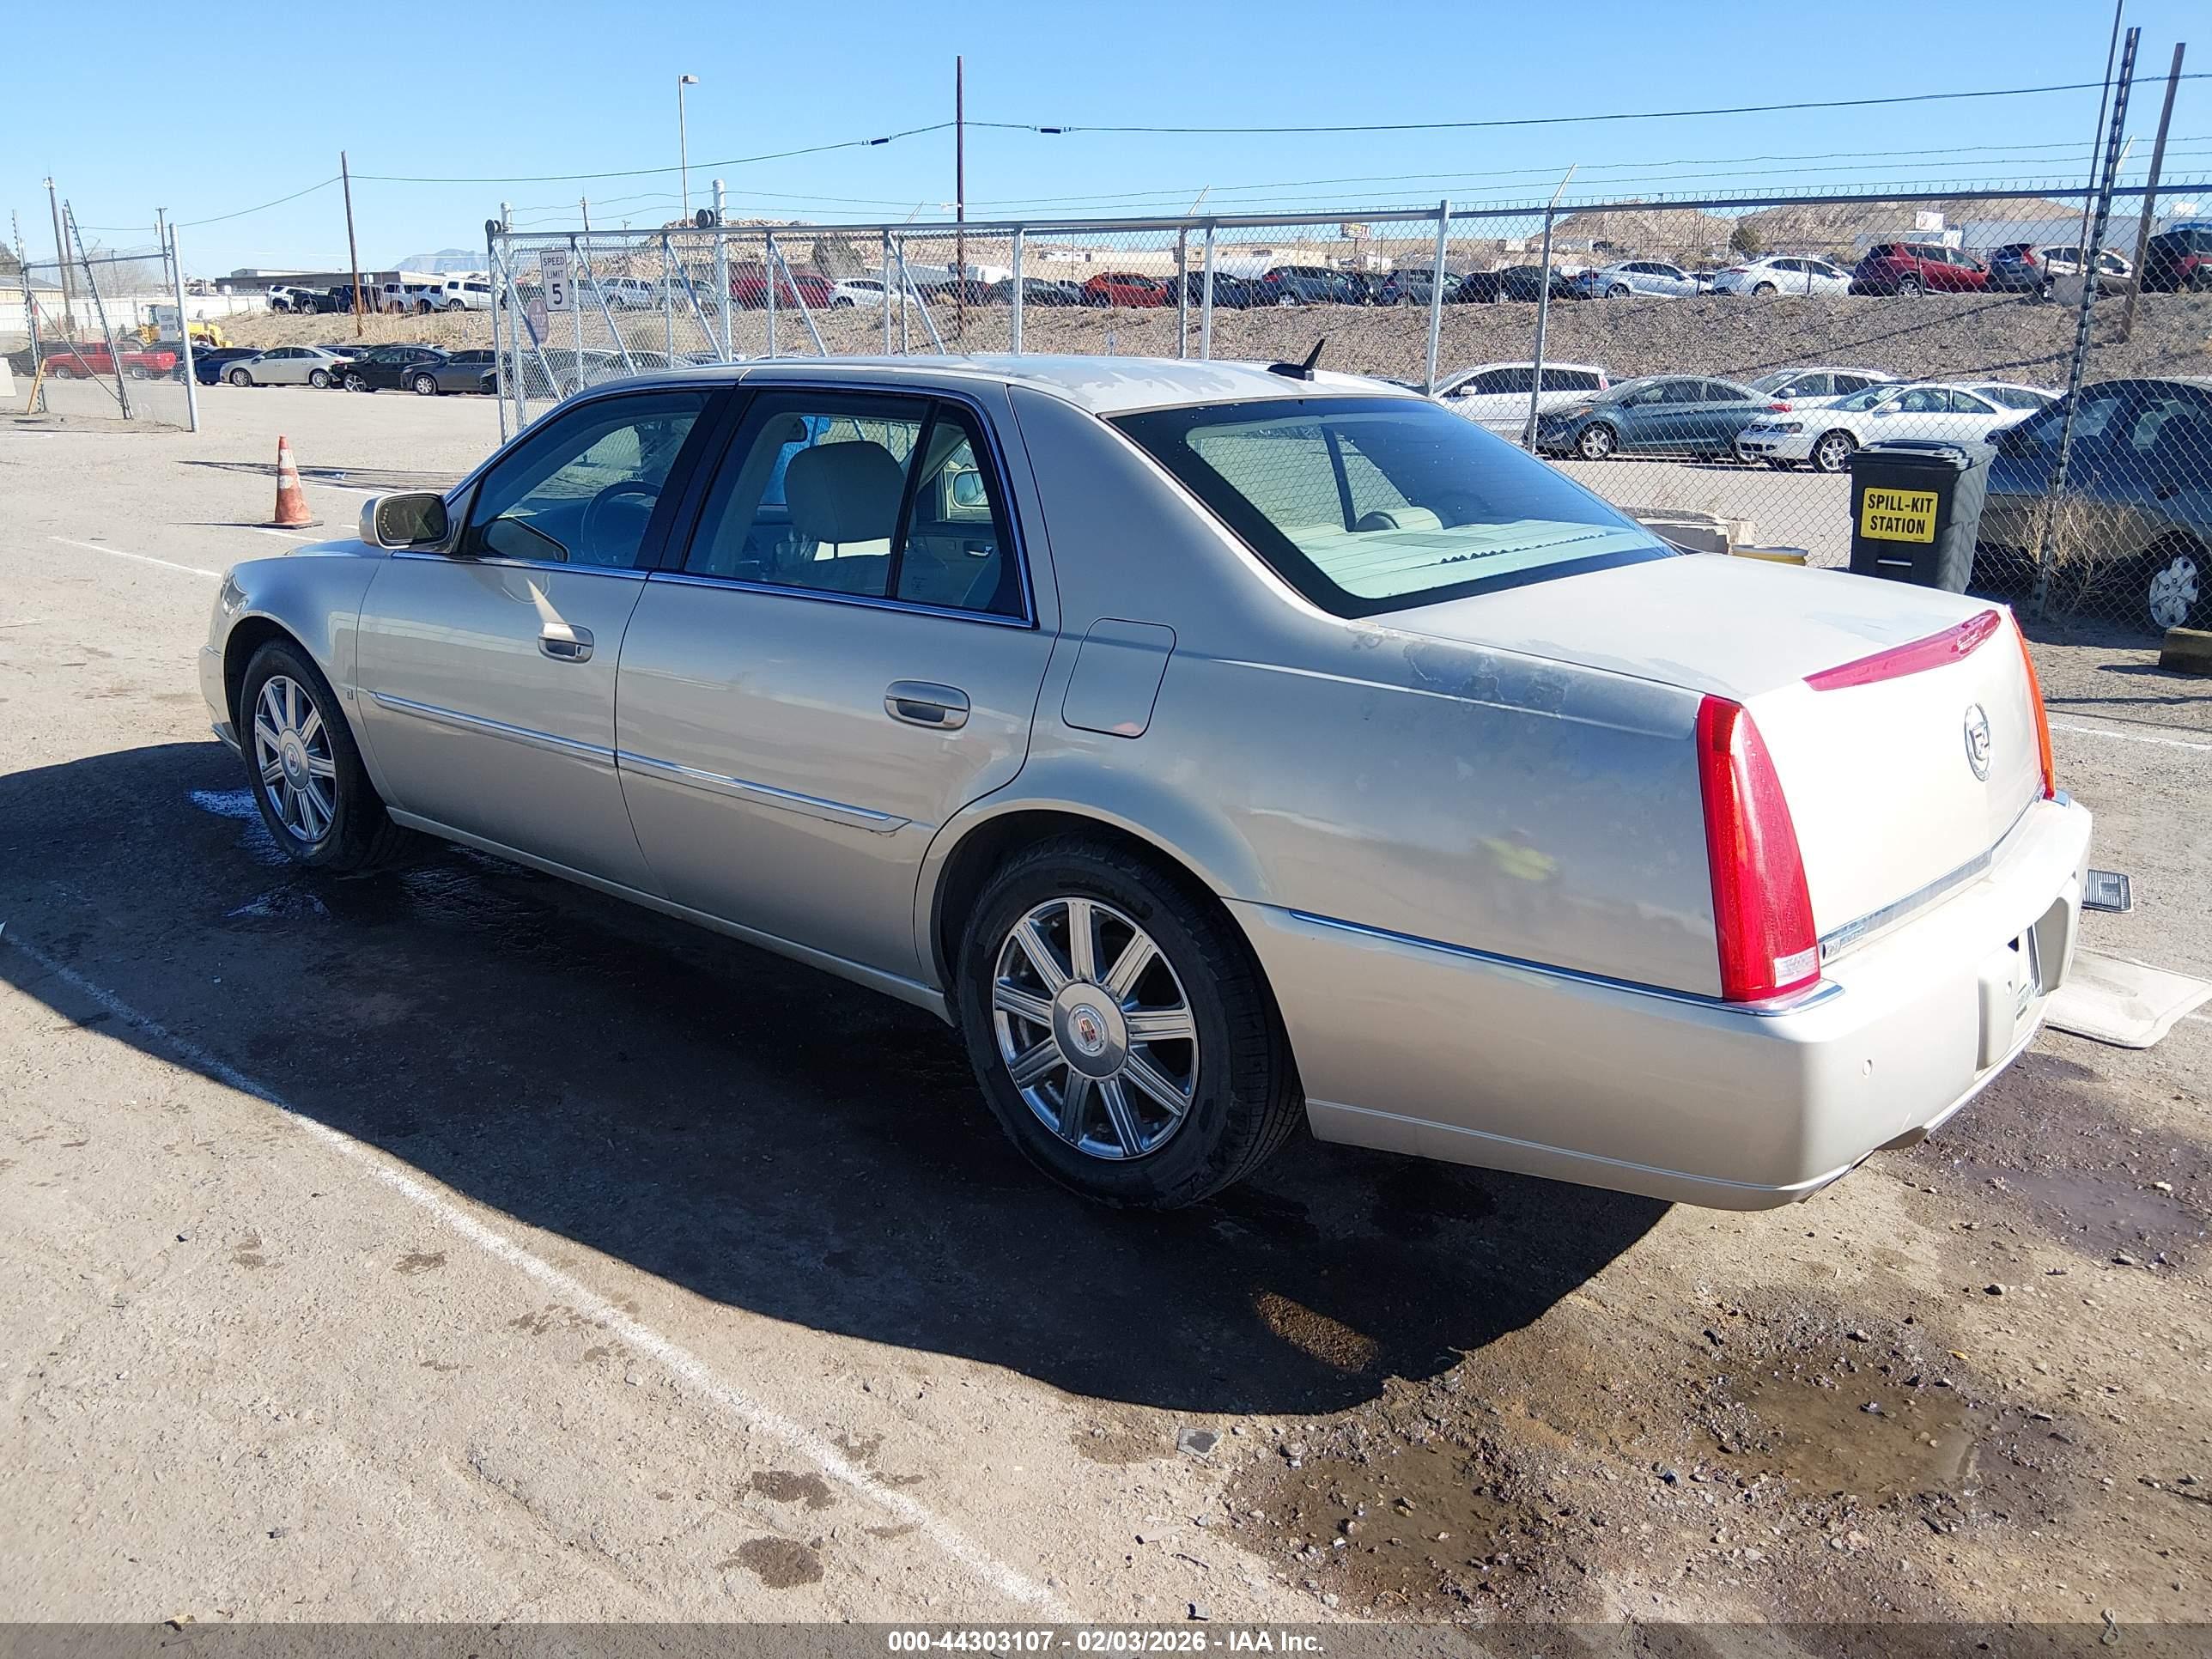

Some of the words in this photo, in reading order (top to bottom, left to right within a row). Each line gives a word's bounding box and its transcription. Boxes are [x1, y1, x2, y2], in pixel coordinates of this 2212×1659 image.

[543, 257, 565, 266] SPEED
[546, 270, 563, 279] LIMIT
[552, 283, 562, 305] 5
[531, 314, 547, 326] STOP
[1868, 493, 1934, 514] SPILL-KIT
[1869, 515, 1926, 535] STATION
